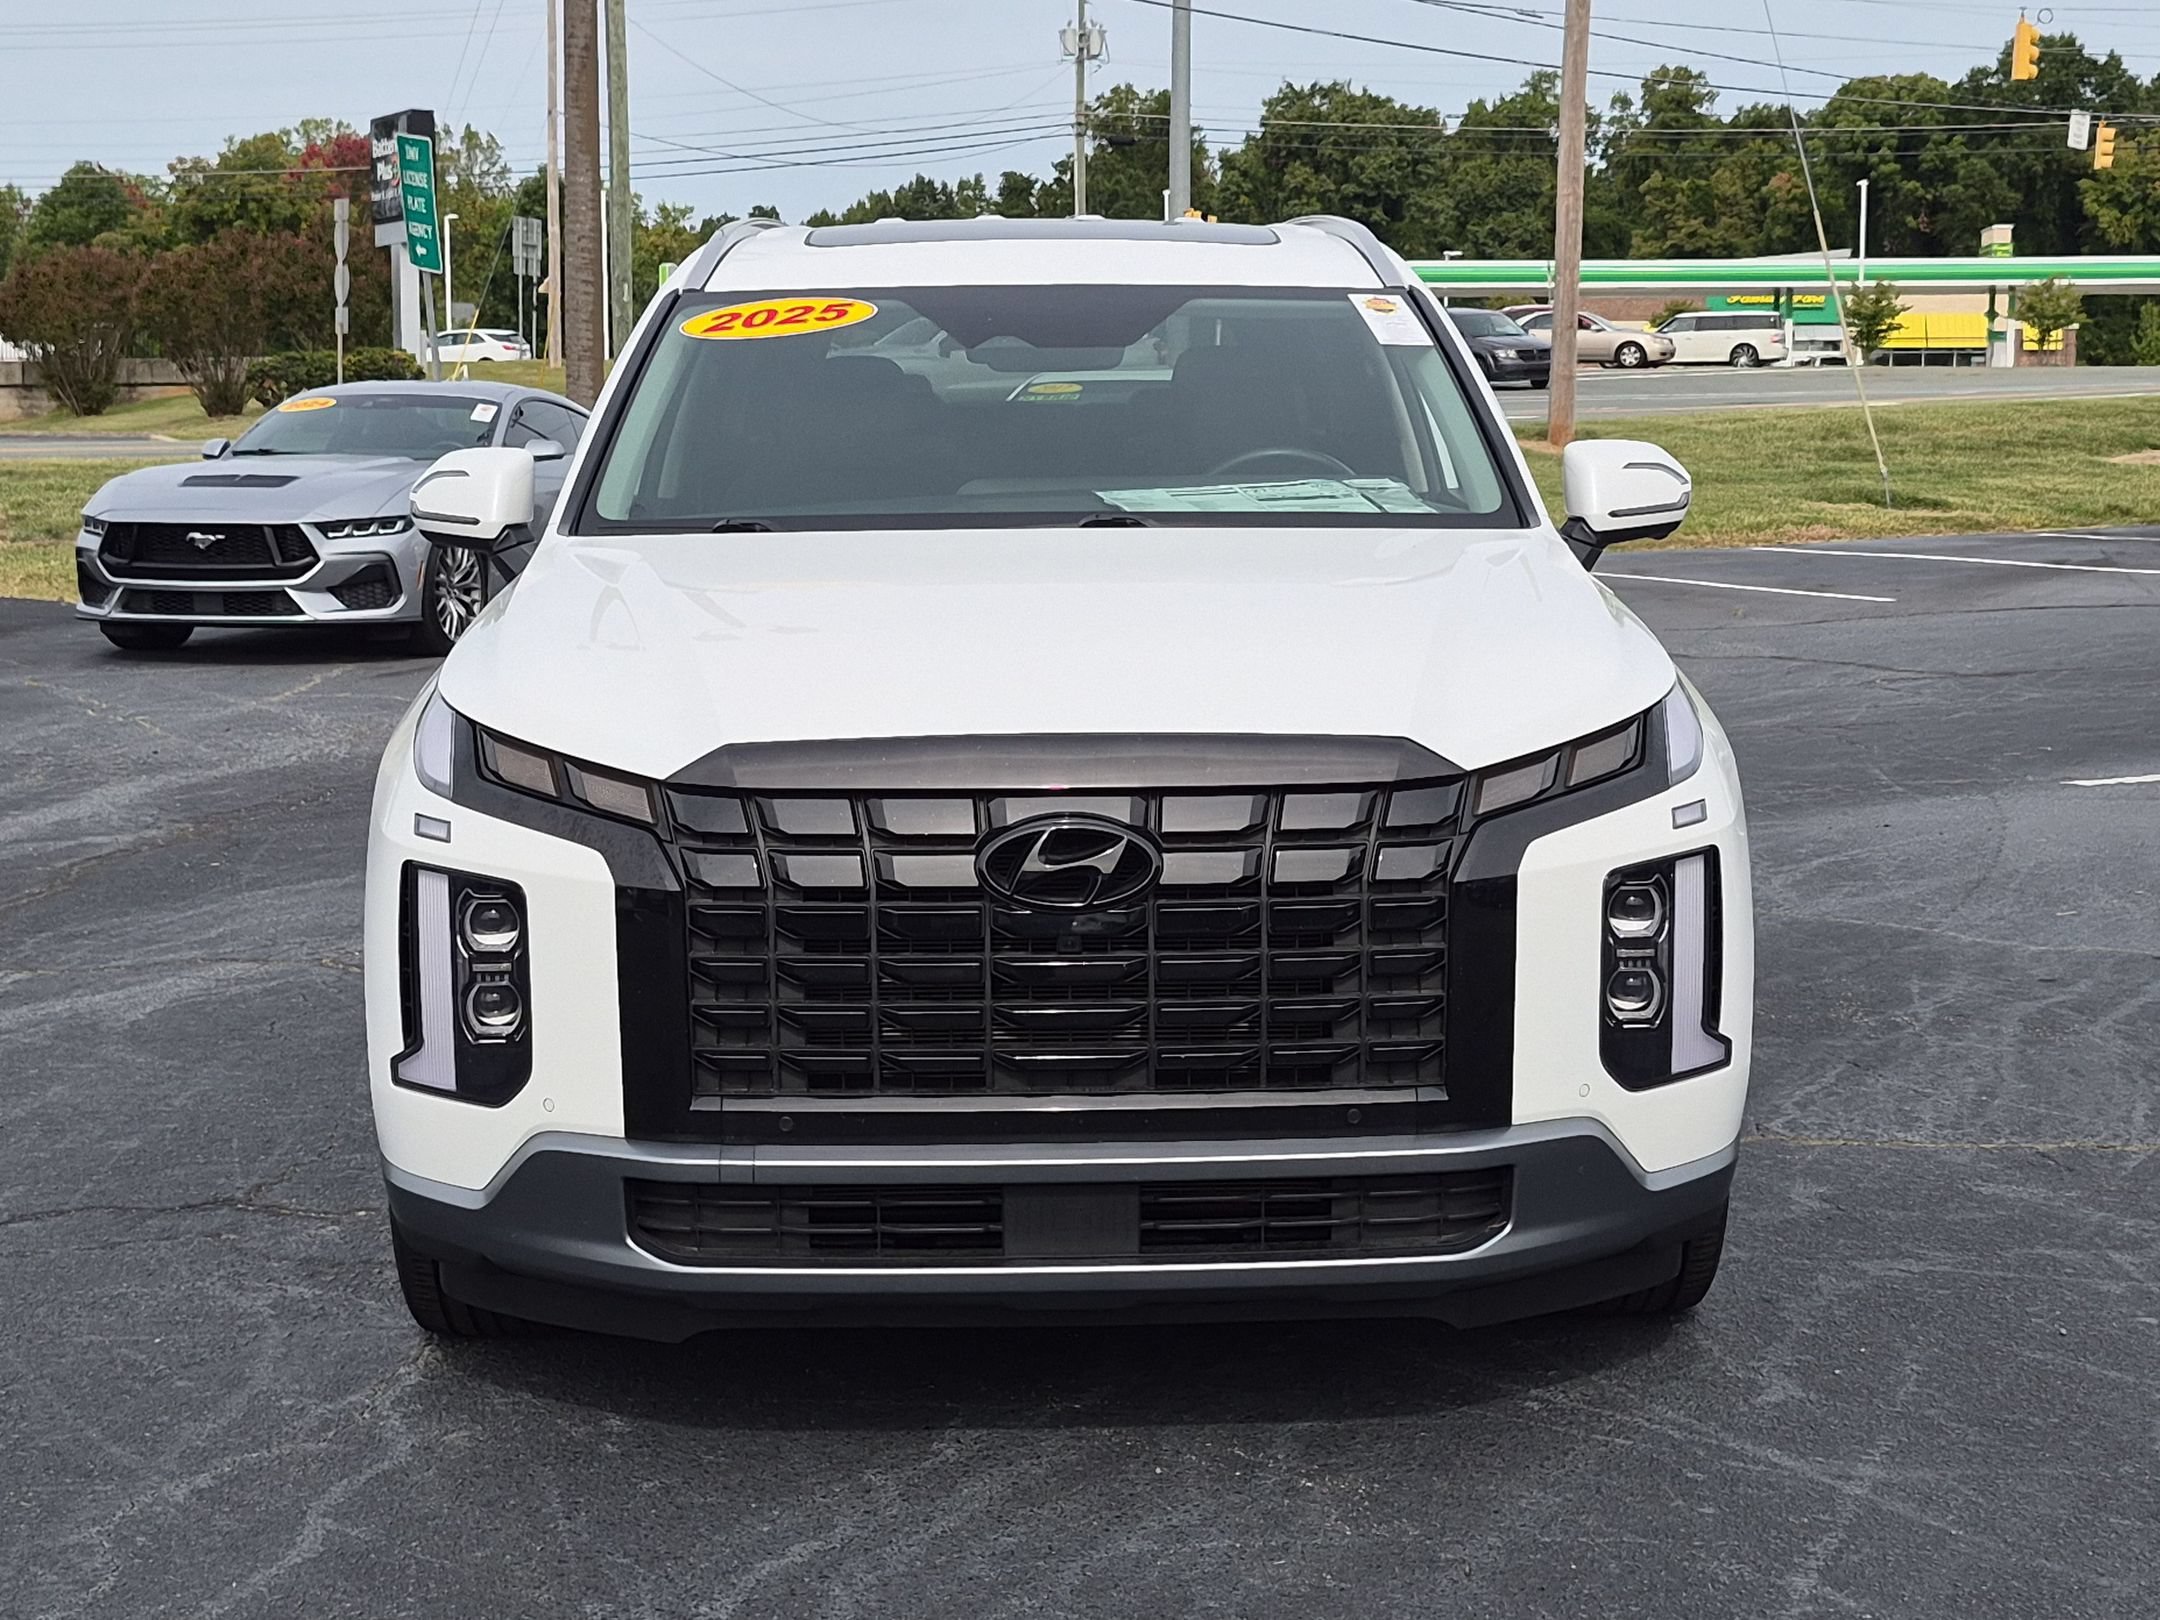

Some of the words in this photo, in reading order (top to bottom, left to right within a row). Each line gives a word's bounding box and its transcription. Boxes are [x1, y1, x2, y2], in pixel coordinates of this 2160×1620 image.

[403, 171, 428, 189] LICENSE
[407, 196, 427, 213] PLATE
[408, 222, 433, 240] AGENCY
[701, 303, 854, 333] 2025
